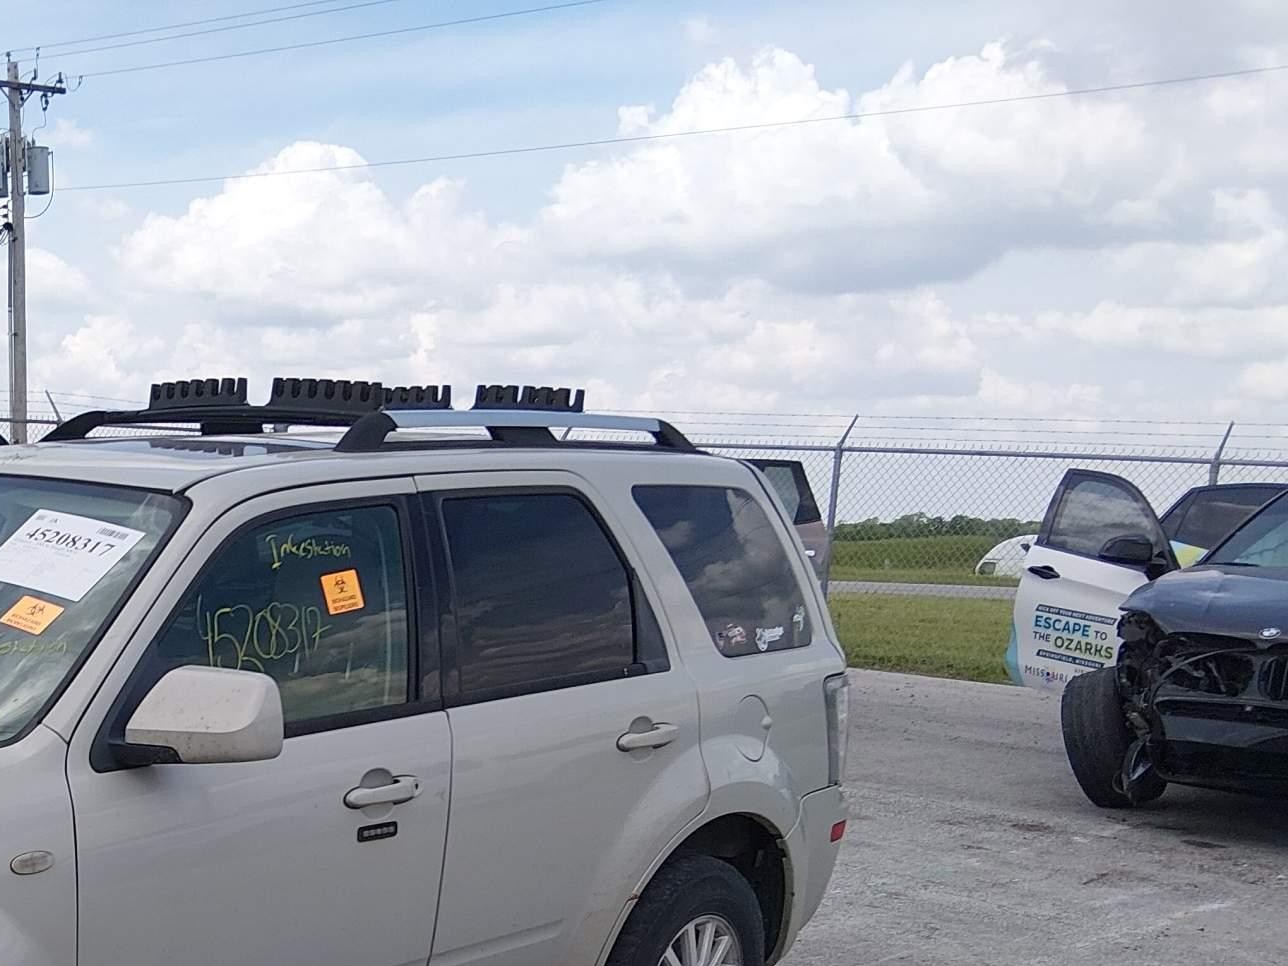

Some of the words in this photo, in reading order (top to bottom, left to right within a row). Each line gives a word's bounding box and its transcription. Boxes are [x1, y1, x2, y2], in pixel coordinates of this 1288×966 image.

[26, 527, 117, 556] 45208317
[196, 594, 332, 672] 45208317
[1034, 615, 1091, 637] ESCAPE
[1094, 630, 1108, 641] TO
[1032, 631, 1051, 642] THE
[1054, 636, 1114, 659] OZARKS
